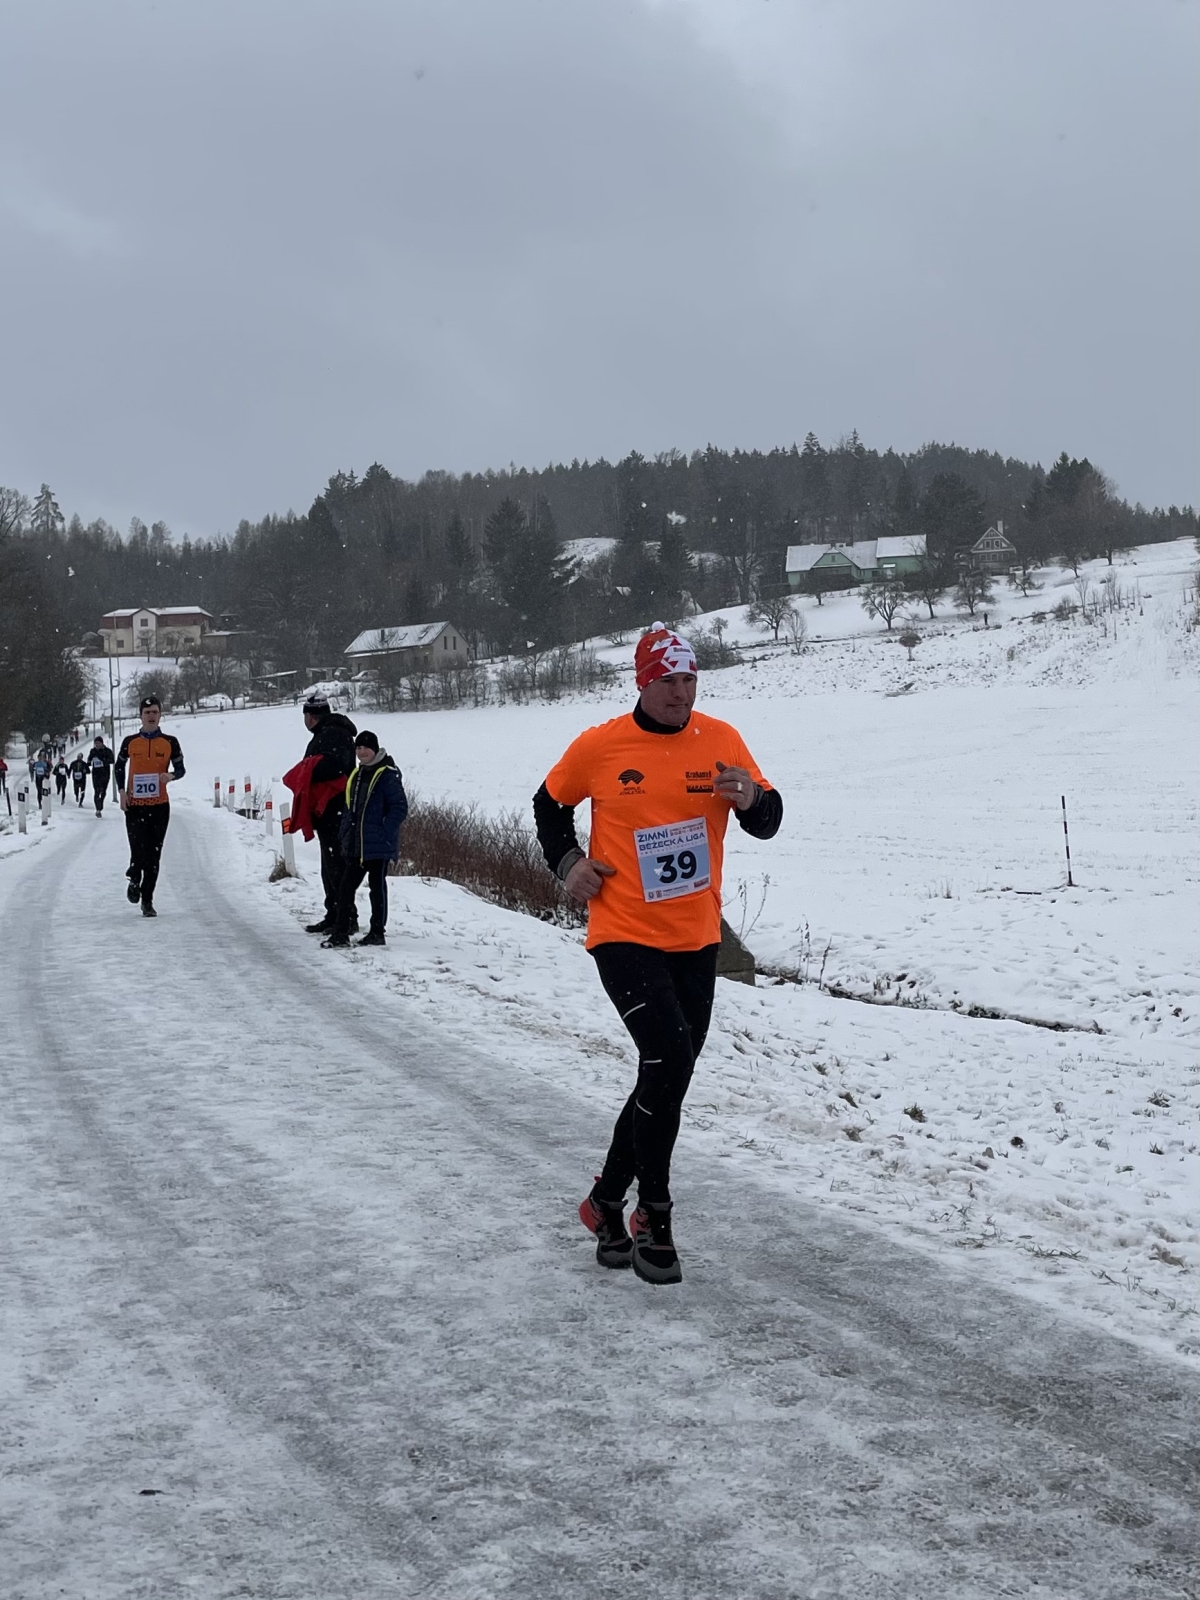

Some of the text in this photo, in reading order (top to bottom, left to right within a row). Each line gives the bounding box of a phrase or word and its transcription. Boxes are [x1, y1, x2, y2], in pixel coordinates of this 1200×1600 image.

[136, 783, 156, 793] 210
[637, 828, 668, 842] ZIMNÍ
[686, 832, 705, 842] LIGA
[656, 850, 697, 884] 39
